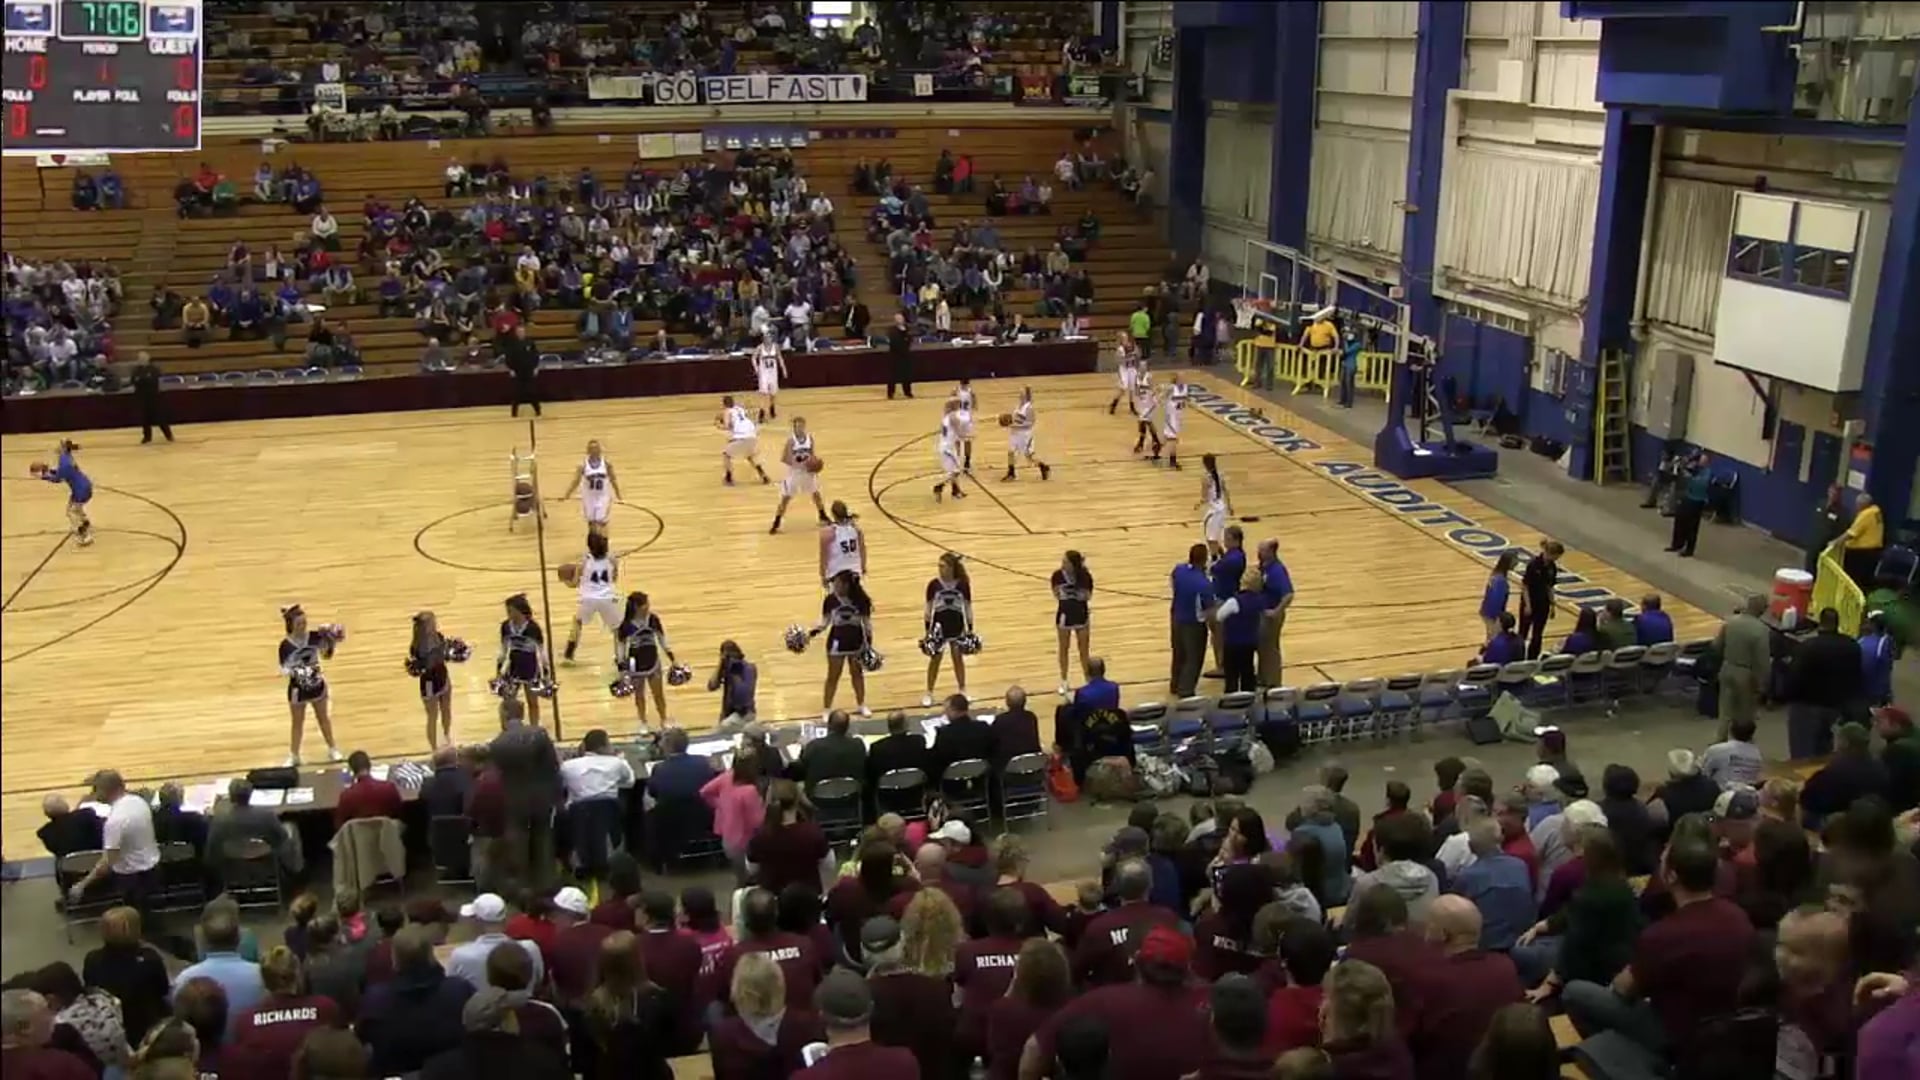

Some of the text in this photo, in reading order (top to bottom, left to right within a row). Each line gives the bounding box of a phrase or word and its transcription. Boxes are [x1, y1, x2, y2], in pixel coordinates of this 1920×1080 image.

[82, 3, 138, 34] 7:06
[5, 37, 47, 52] HOME
[149, 39, 194, 54] GUEST
[656, 78, 694, 101] GO
[1308, 461, 1642, 622] AUDITORU
[590, 570, 608, 583] 44
[253, 1008, 317, 1025] RICHARDS
